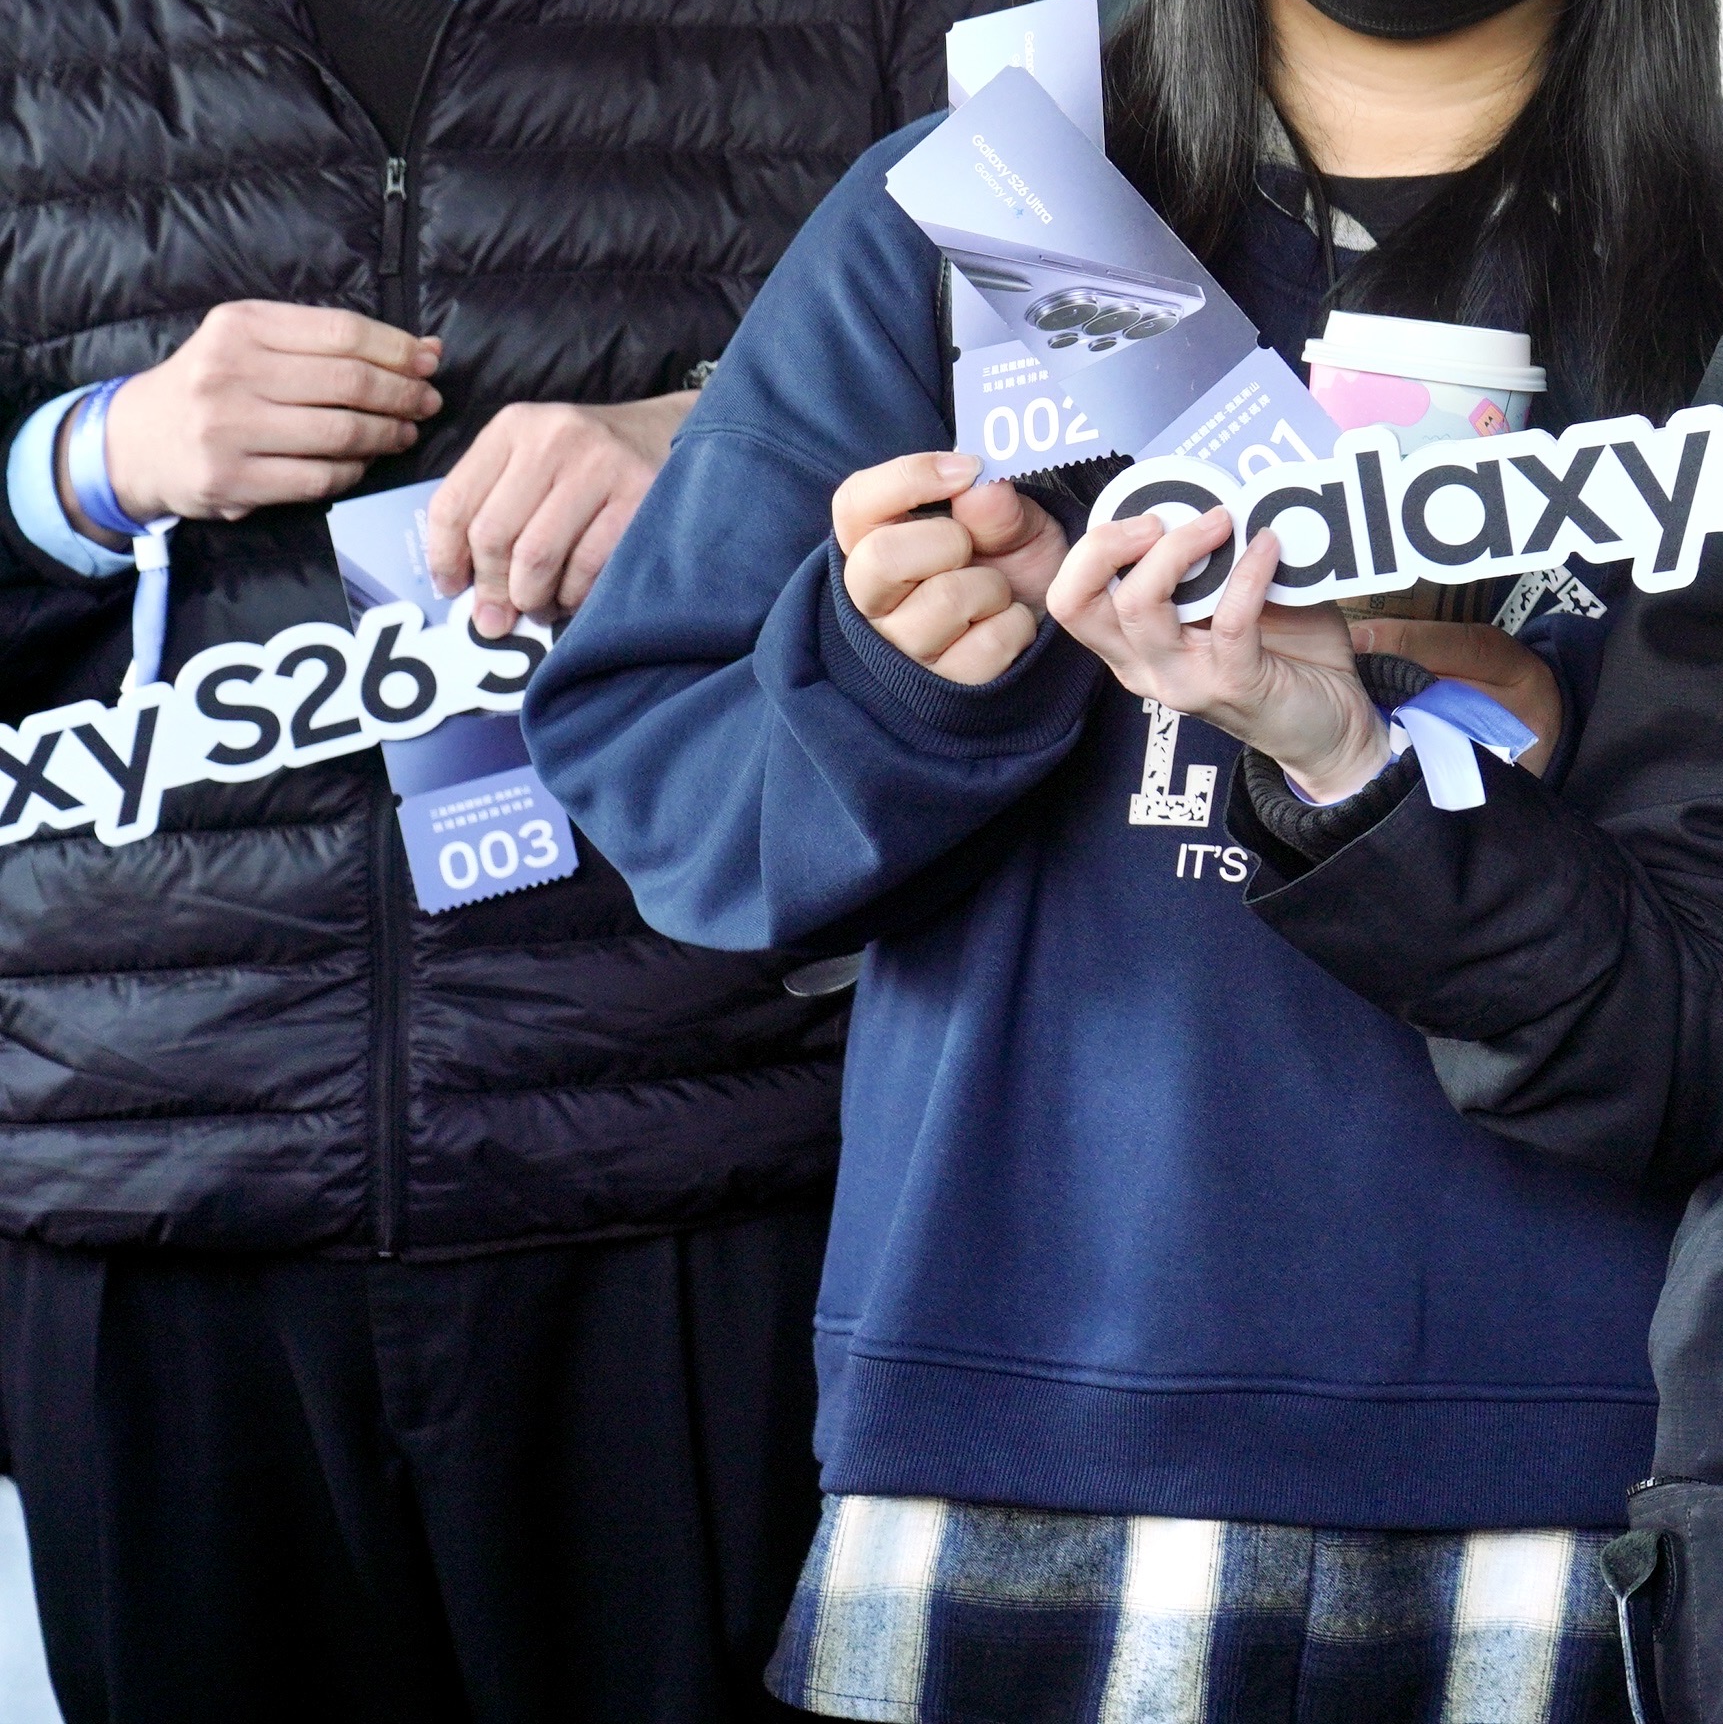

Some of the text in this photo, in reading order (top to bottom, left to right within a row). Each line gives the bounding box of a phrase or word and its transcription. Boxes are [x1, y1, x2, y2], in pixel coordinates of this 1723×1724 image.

[972, 134, 1053, 225] Galaxy S26 Ultra
[974, 162, 1017, 209] Galaxy AI
[983, 396, 1099, 461] 002
[195, 622, 438, 767] S26
[439, 819, 559, 890] 003
[1176, 843, 1249, 883] IT'S
